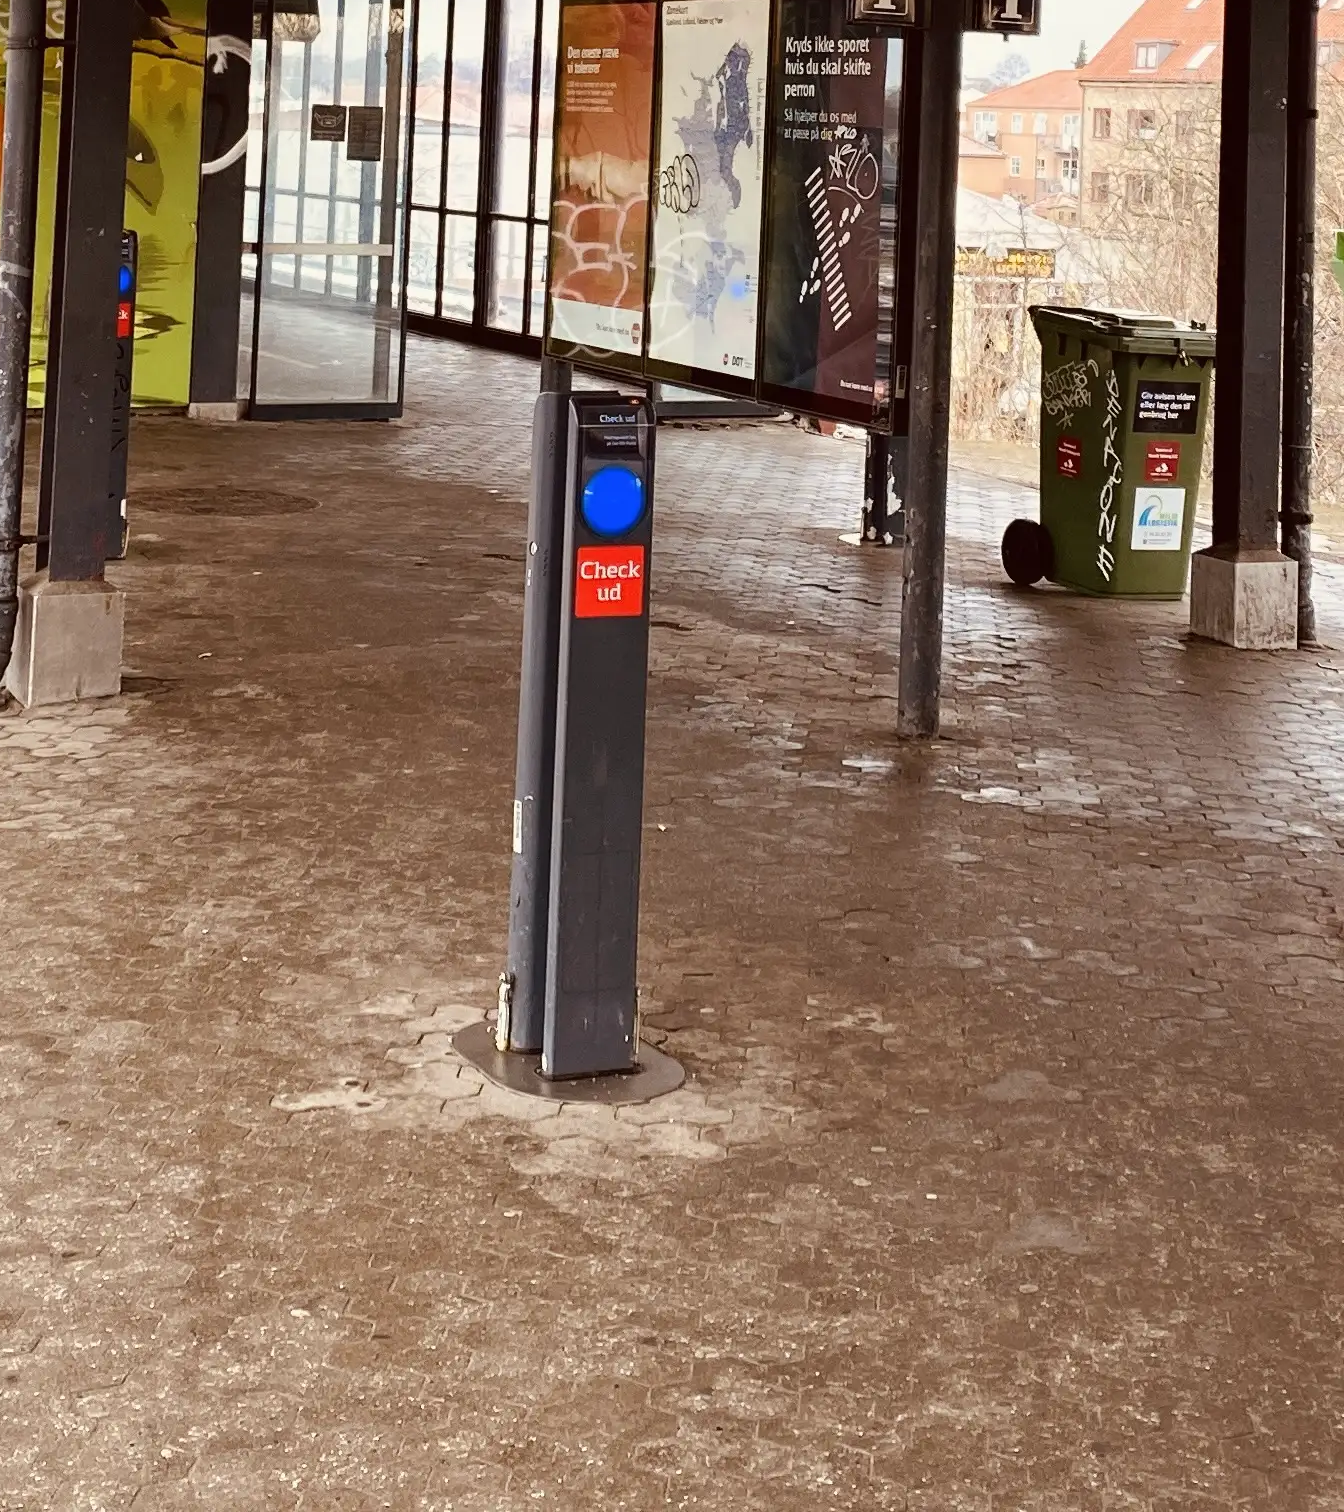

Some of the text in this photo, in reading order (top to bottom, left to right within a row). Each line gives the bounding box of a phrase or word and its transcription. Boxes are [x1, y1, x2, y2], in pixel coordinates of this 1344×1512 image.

[785, 35, 870, 57] Kryds ikke sporet
[785, 57, 871, 76] hvis du skal skifte
[784, 83, 815, 101] perron
[784, 108, 793, 122] Så
[818, 109, 828, 123] du
[829, 112, 840, 123] os
[841, 111, 857, 124] med
[810, 126, 820, 142] på
[820, 127, 833, 143] dig
[579, 560, 641, 580] Check
[596, 583, 622, 602] ud
